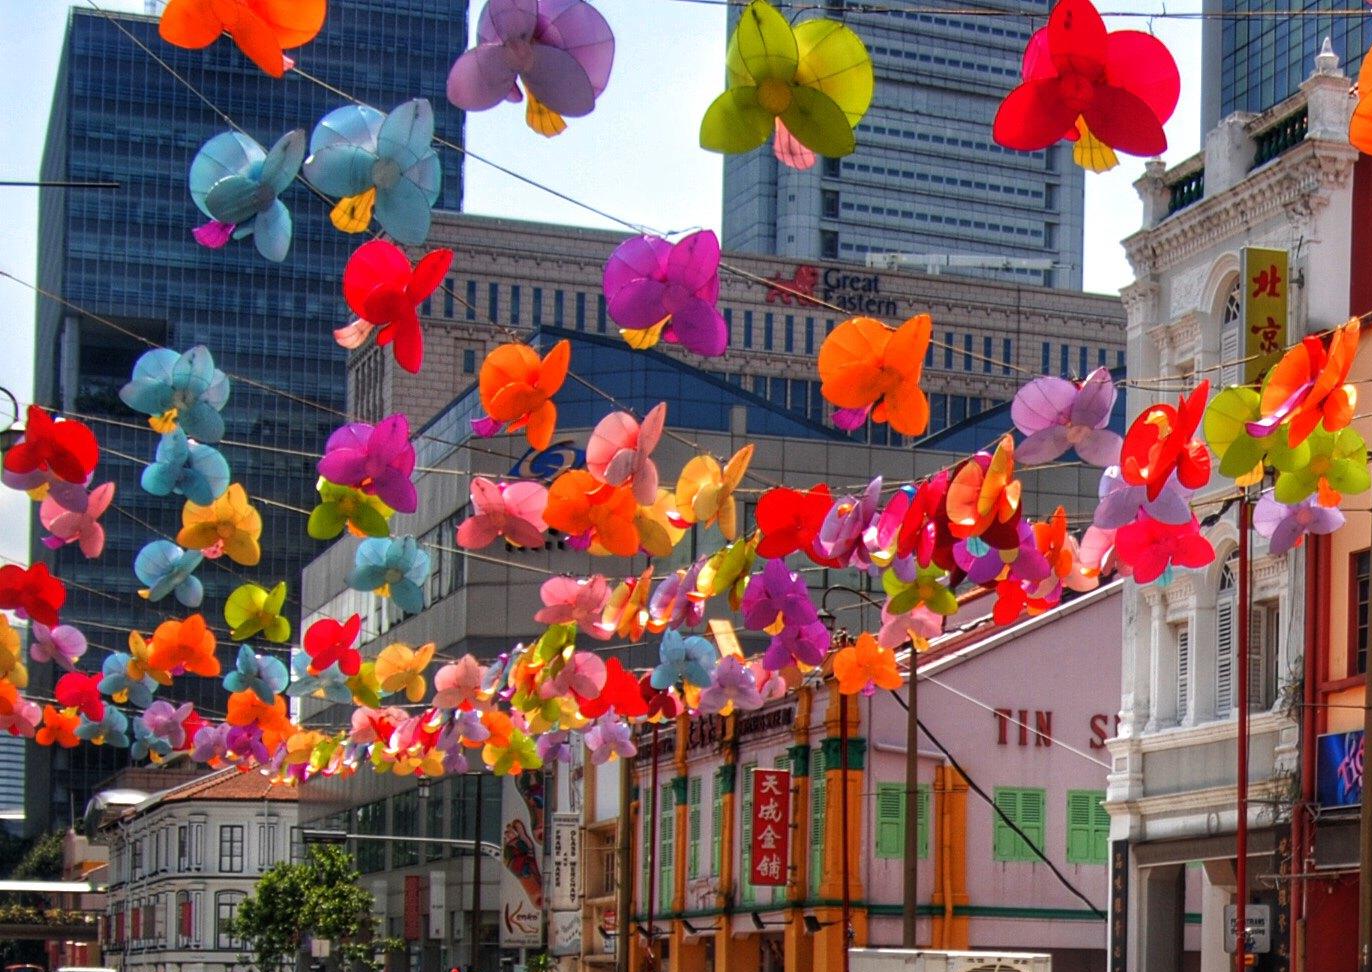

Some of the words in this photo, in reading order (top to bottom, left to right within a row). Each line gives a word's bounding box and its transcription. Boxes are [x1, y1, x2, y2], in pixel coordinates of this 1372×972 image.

[823, 267, 880, 293] Great
[822, 288, 898, 316] Eastern
[993, 708, 1052, 748] TIN
